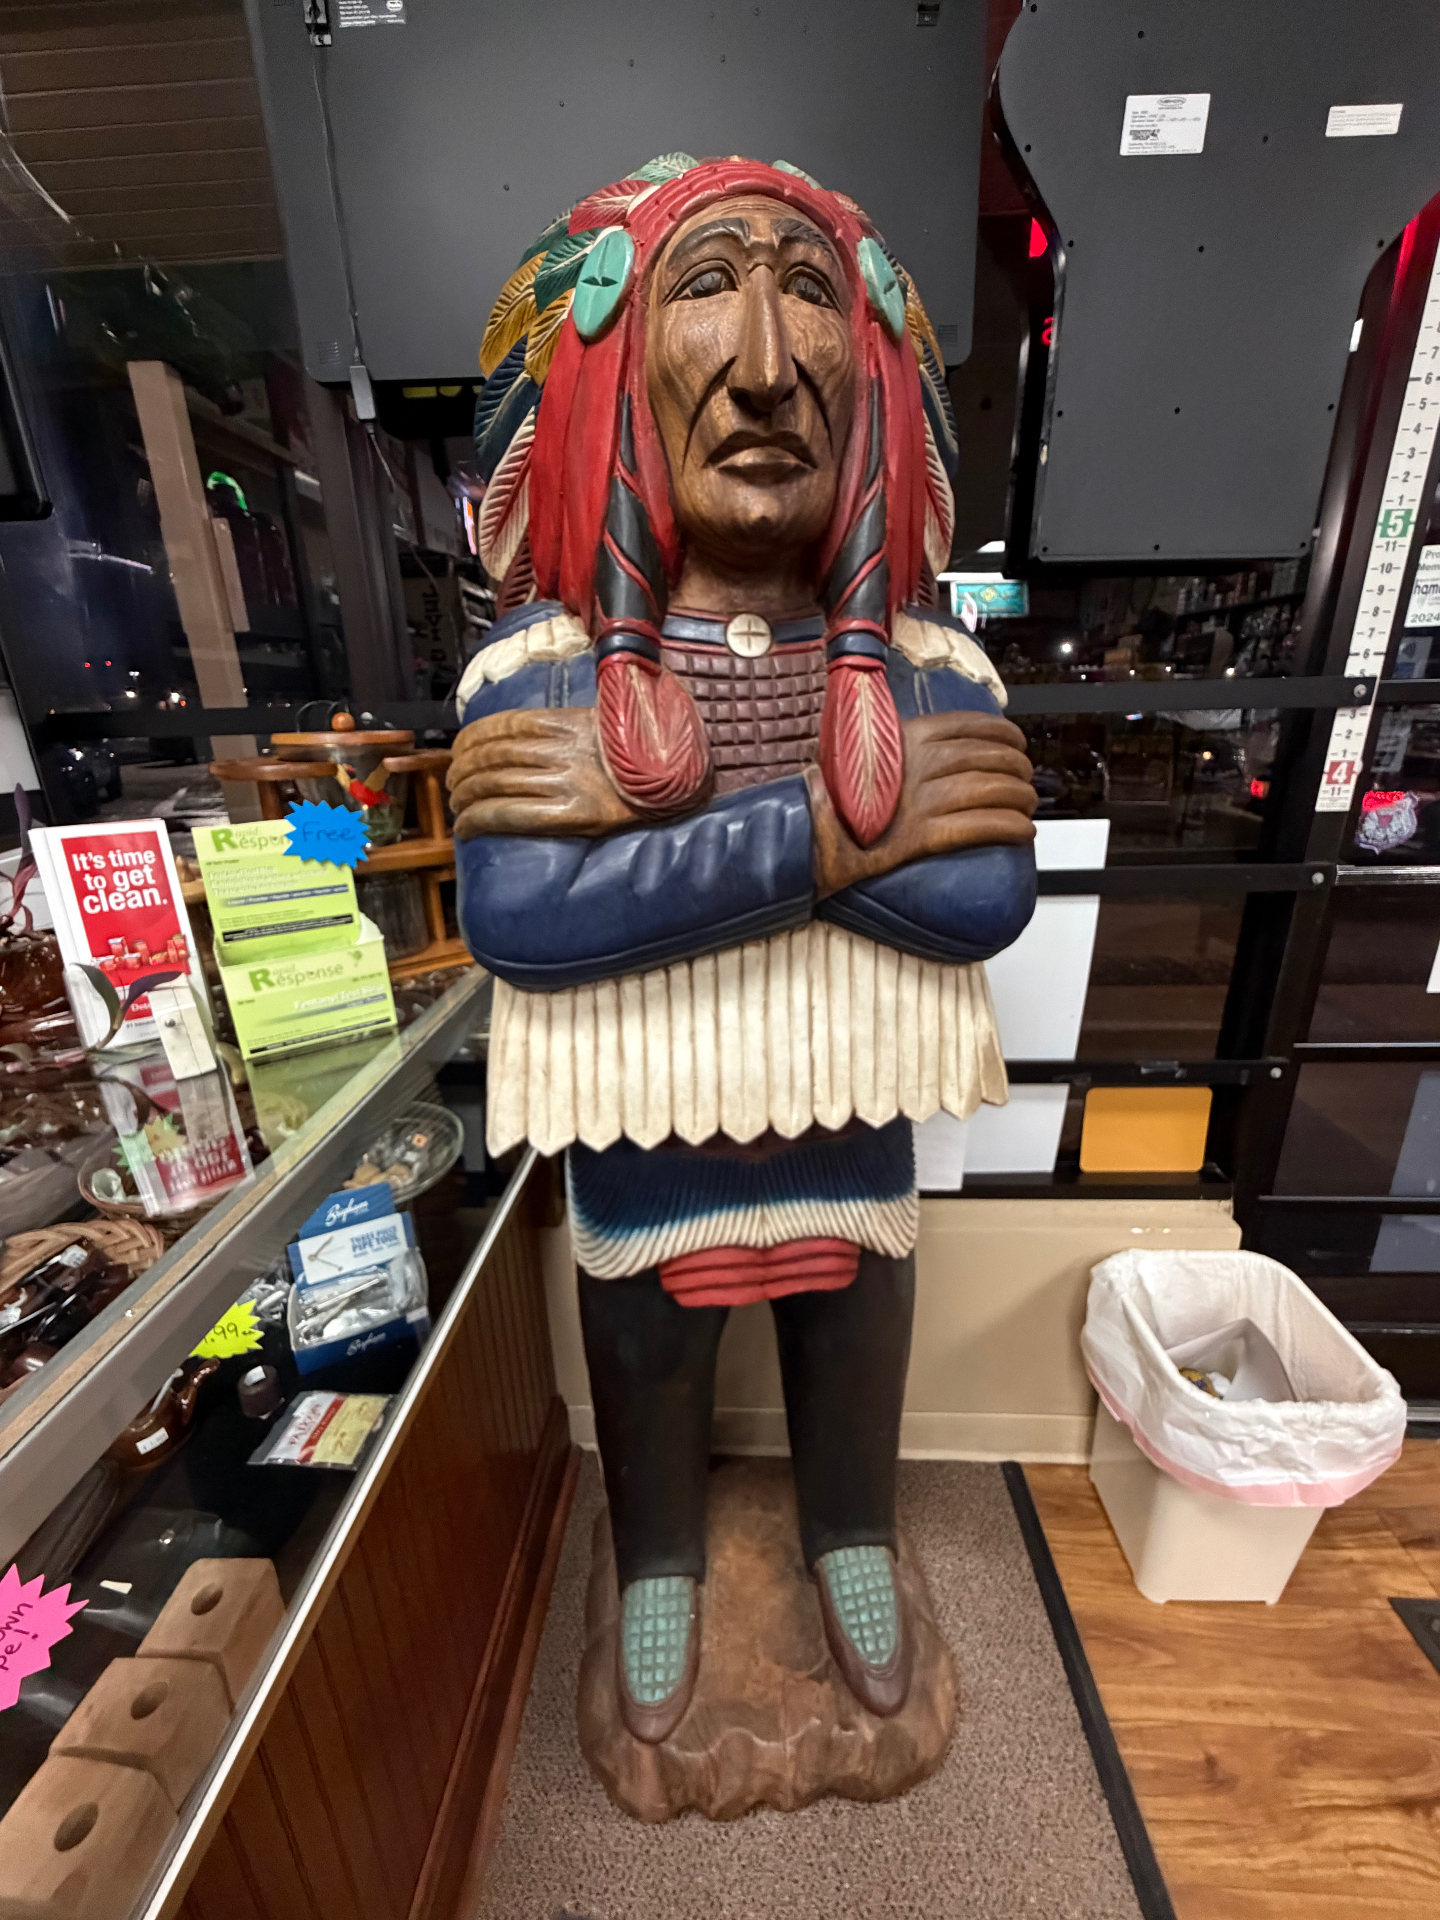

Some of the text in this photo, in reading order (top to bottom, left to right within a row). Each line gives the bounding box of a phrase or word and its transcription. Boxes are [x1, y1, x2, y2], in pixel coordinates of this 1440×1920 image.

[1424, 372, 1433, 385] 6
[1419, 398, 1428, 410] 5
[1413, 423, 1422, 435] 4
[1407, 447, 1416, 459] 3
[1402, 471, 1411, 483] 2
[1398, 494, 1404, 506] 1
[1386, 510, 1406, 537] 5
[1384, 540, 1398, 552] 11
[1380, 562, 1393, 574] 10
[1376, 584, 1385, 596] 9
[1372, 606, 1380, 617] 8
[1411, 612, 1440, 624] 2024
[1368, 627, 1376, 638] 7
[1363, 648, 1370, 660] 6
[1345, 729, 1353, 739] 2
[1342, 749, 1347, 758] 1
[1331, 761, 1349, 784] 4
[1330, 786, 1342, 796] 11
[302, 820, 356, 843] Free
[72, 849, 156, 872] It's time
[83, 864, 156, 892] to get
[83, 887, 168, 914] clean.
[204, 1322, 239, 1343] .99
